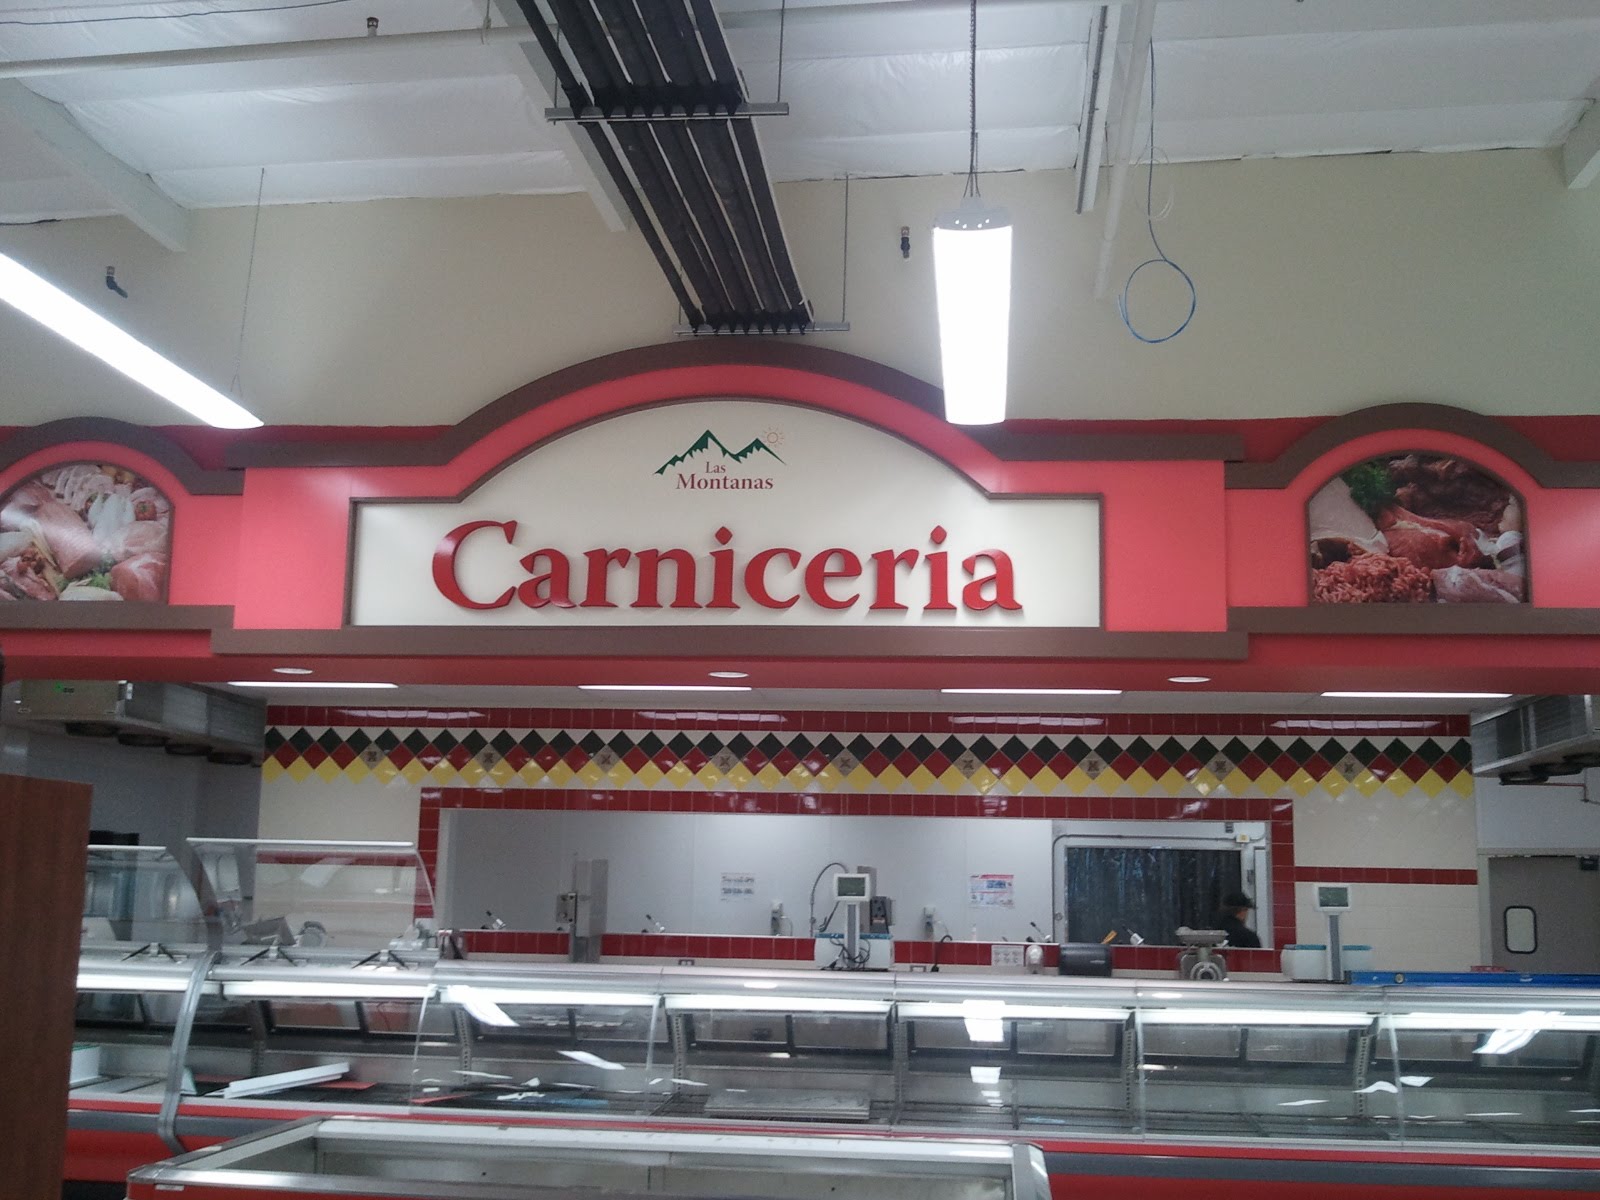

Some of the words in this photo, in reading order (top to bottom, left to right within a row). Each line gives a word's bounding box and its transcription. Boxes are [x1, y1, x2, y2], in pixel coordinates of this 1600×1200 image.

[705, 461, 726, 473] Las
[676, 473, 774, 490] Montanas
[432, 520, 1023, 611] Carniceria
